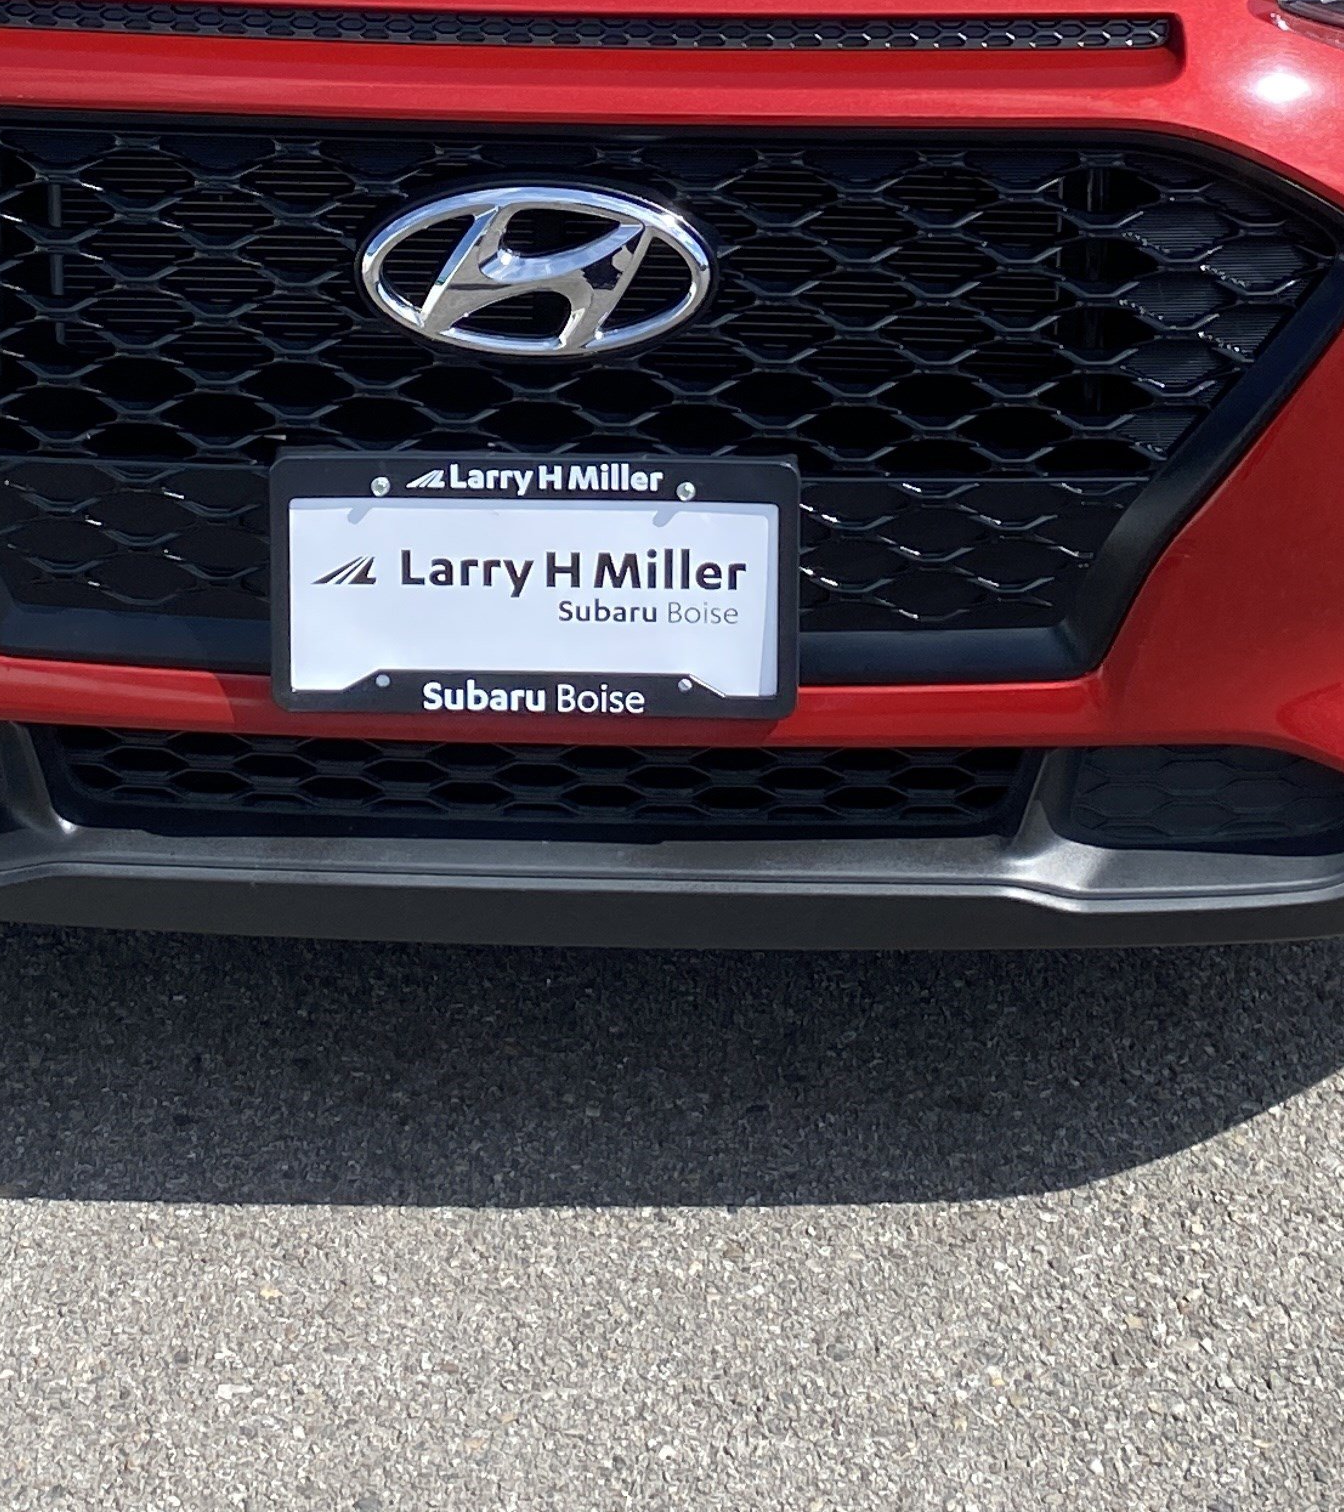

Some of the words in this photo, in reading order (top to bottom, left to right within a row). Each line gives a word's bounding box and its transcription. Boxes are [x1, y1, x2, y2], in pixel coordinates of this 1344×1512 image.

[449, 464, 534, 496] Larry
[539, 465, 563, 490] H
[568, 464, 664, 492] Miller
[401, 550, 534, 598] Larry
[547, 551, 581, 589] H
[594, 548, 747, 591] Miller
[558, 599, 657, 623] Subaru
[667, 601, 739, 625] Boise
[423, 680, 546, 712] Subaru
[557, 683, 645, 714] Boise
